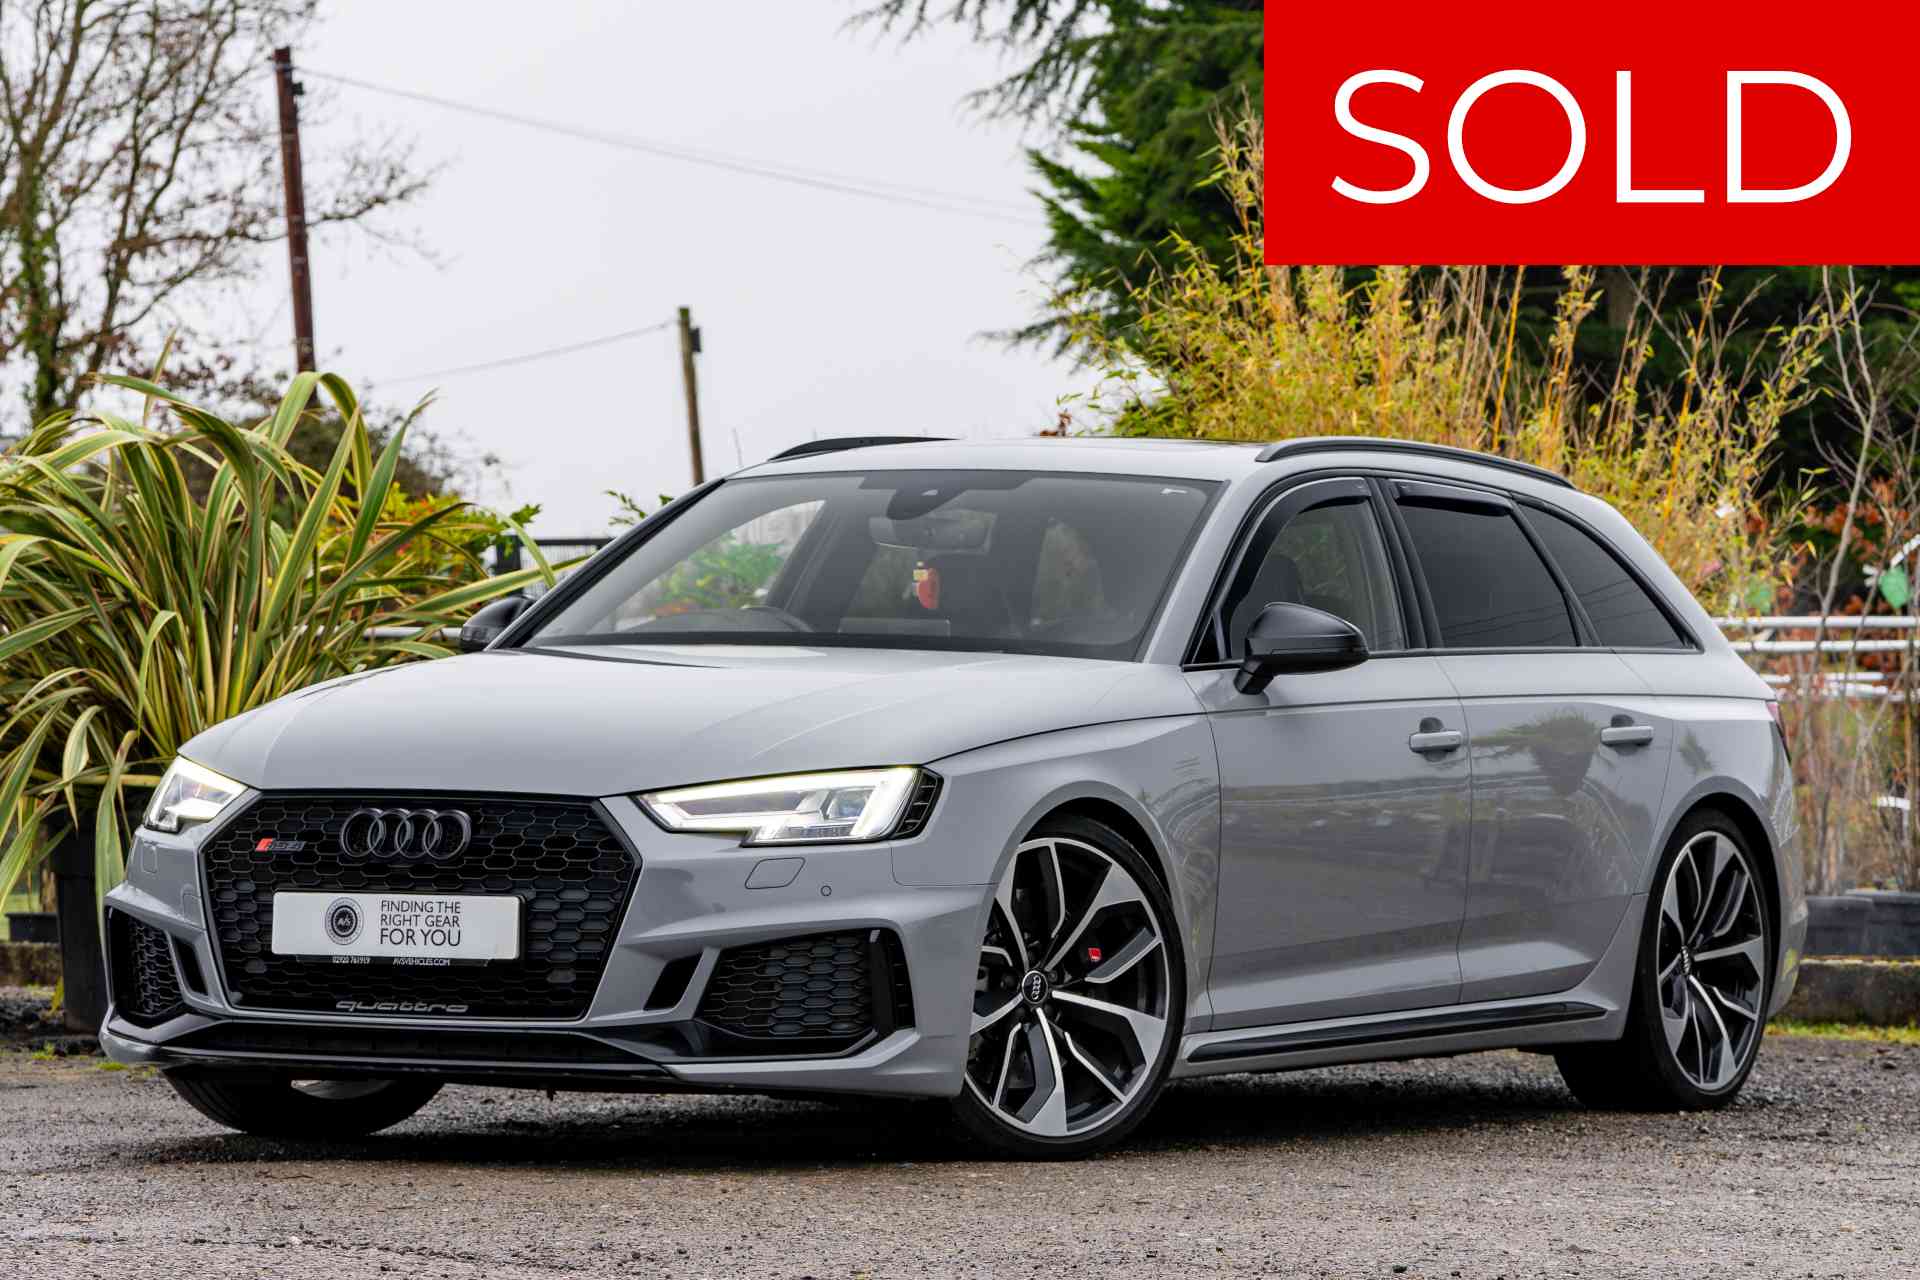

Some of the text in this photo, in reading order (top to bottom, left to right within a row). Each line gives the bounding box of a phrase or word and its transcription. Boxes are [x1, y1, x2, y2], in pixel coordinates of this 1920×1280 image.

[381, 900, 461, 914] FINDING THE
[380, 913, 460, 928] RIGHT GEAR
[380, 928, 461, 947] FOR YOU
[336, 1000, 468, 1013] quattro
